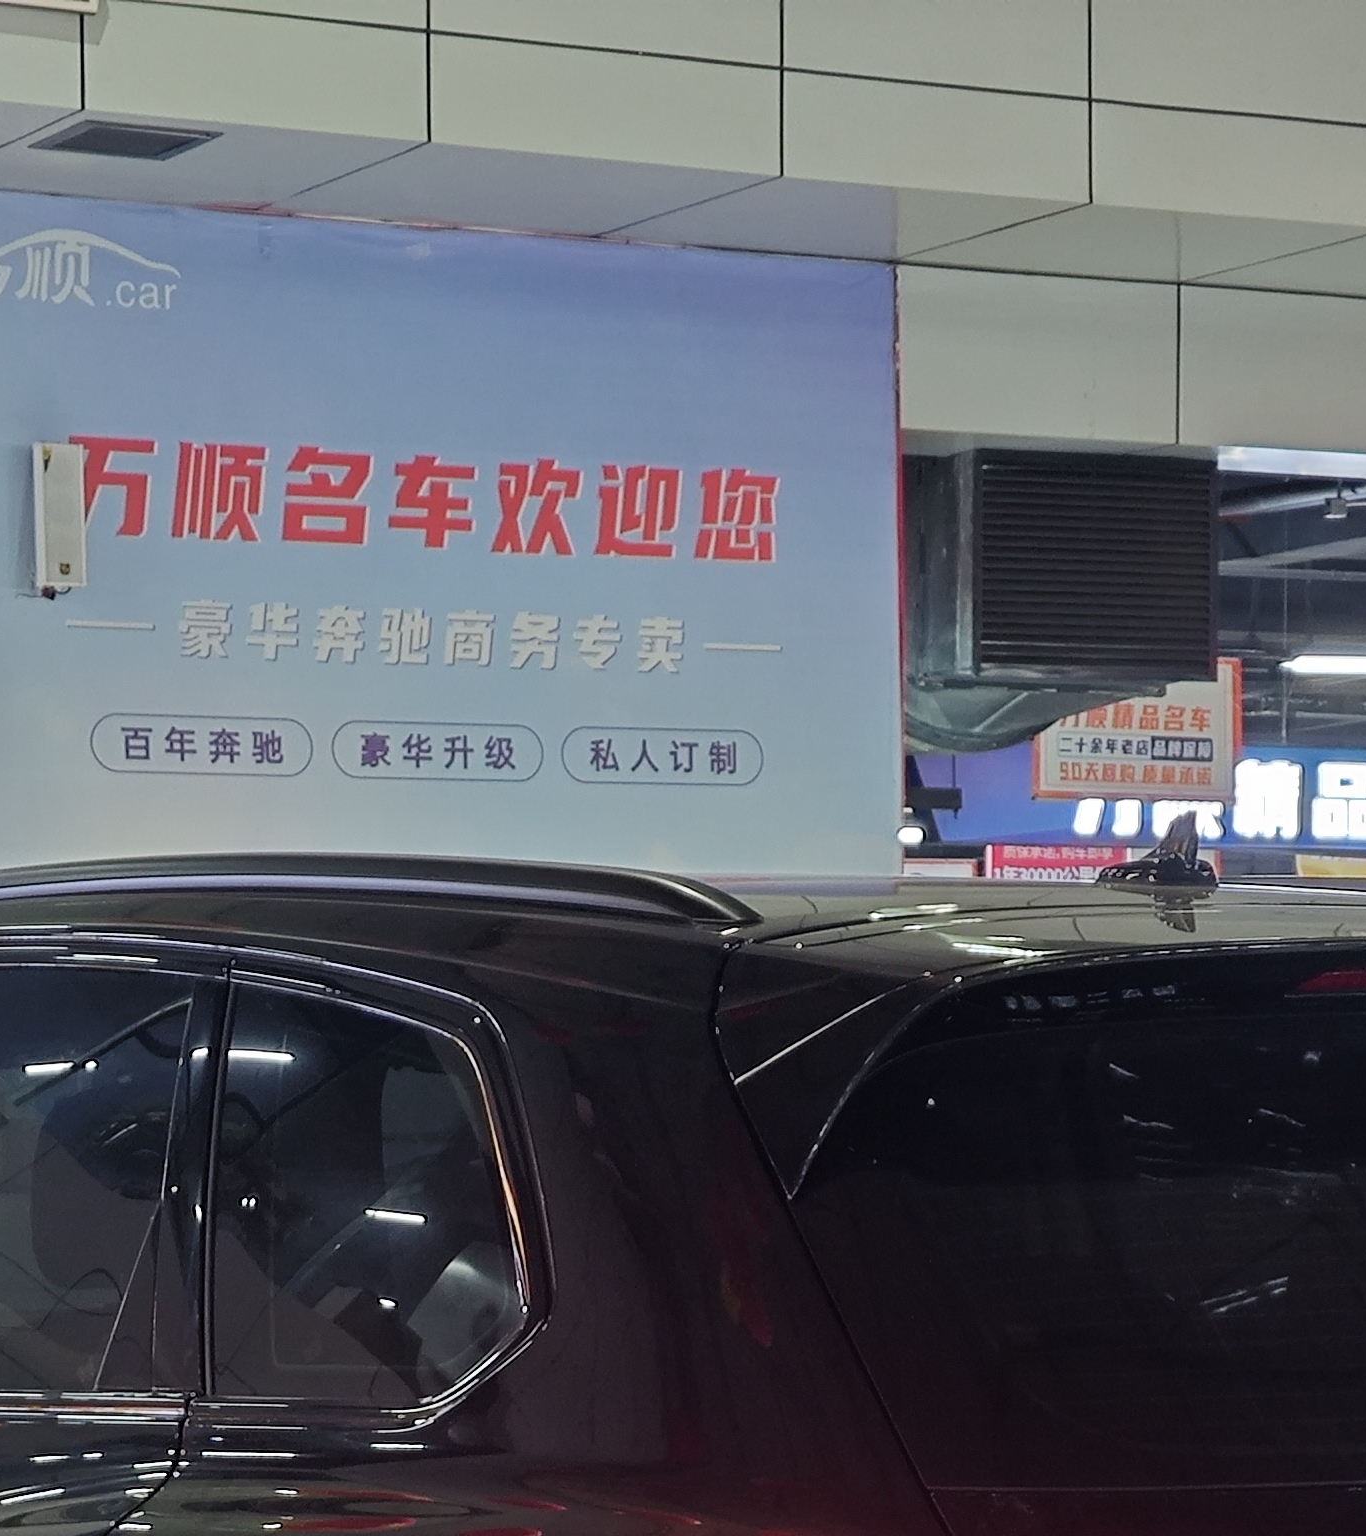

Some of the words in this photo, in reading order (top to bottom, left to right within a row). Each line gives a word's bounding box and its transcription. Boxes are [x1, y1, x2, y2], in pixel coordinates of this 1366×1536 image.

[67, 433, 781, 564] 万顺名车欢迎您
[177, 599, 687, 674] 豪华奔驰商务专卖
[119, 726, 285, 765] 百年奔驰
[359, 733, 518, 772] 豪华升级
[589, 738, 739, 776] 私人订制
